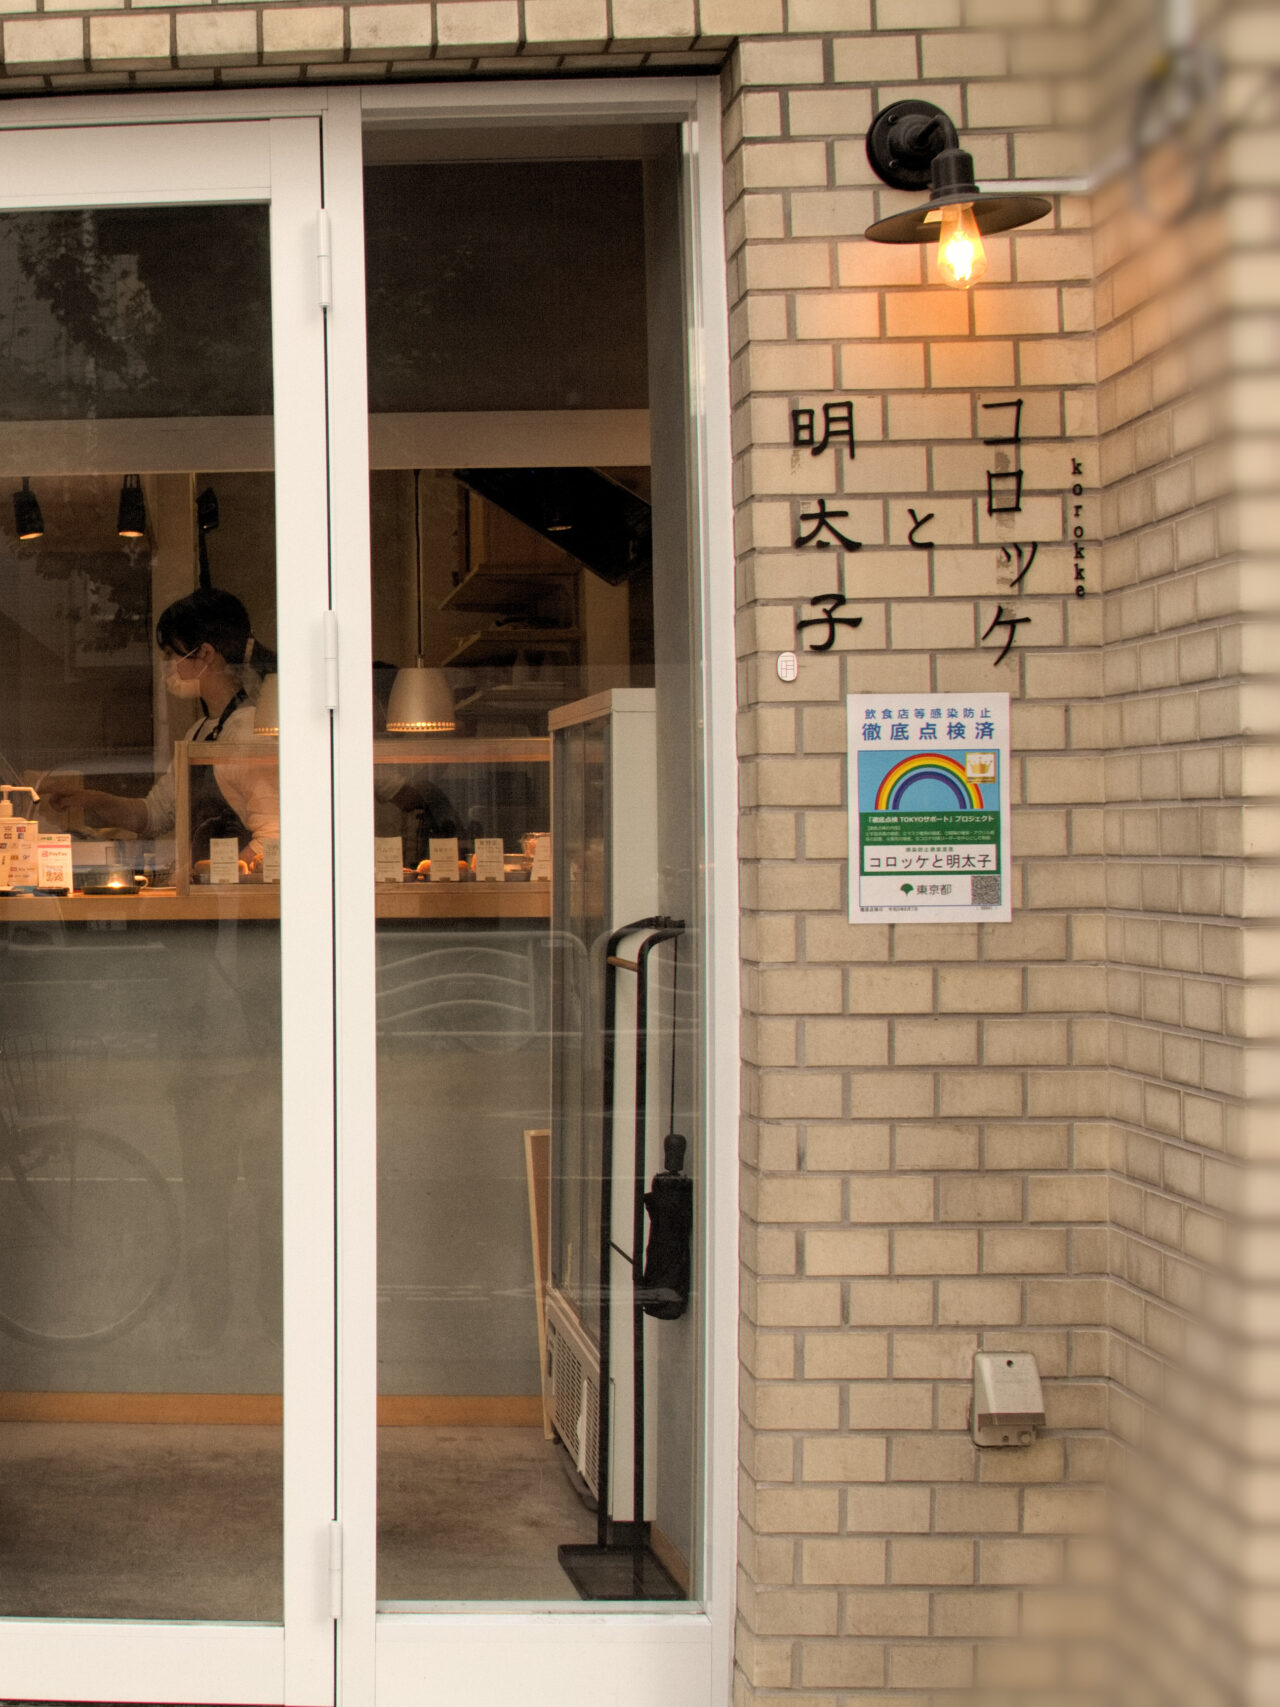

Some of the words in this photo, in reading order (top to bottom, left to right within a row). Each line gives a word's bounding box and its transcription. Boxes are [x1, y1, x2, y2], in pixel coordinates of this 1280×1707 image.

[790, 400, 863, 651] 明太子
[907, 507, 935, 549] と
[1070, 457, 1086, 598] korokke
[864, 707, 992, 720] 飲食店等感染防止
[862, 721, 995, 741] 徹底点検済
[869, 853, 992, 869] コロッケと明太子
[916, 883, 953, 896] 東京都
